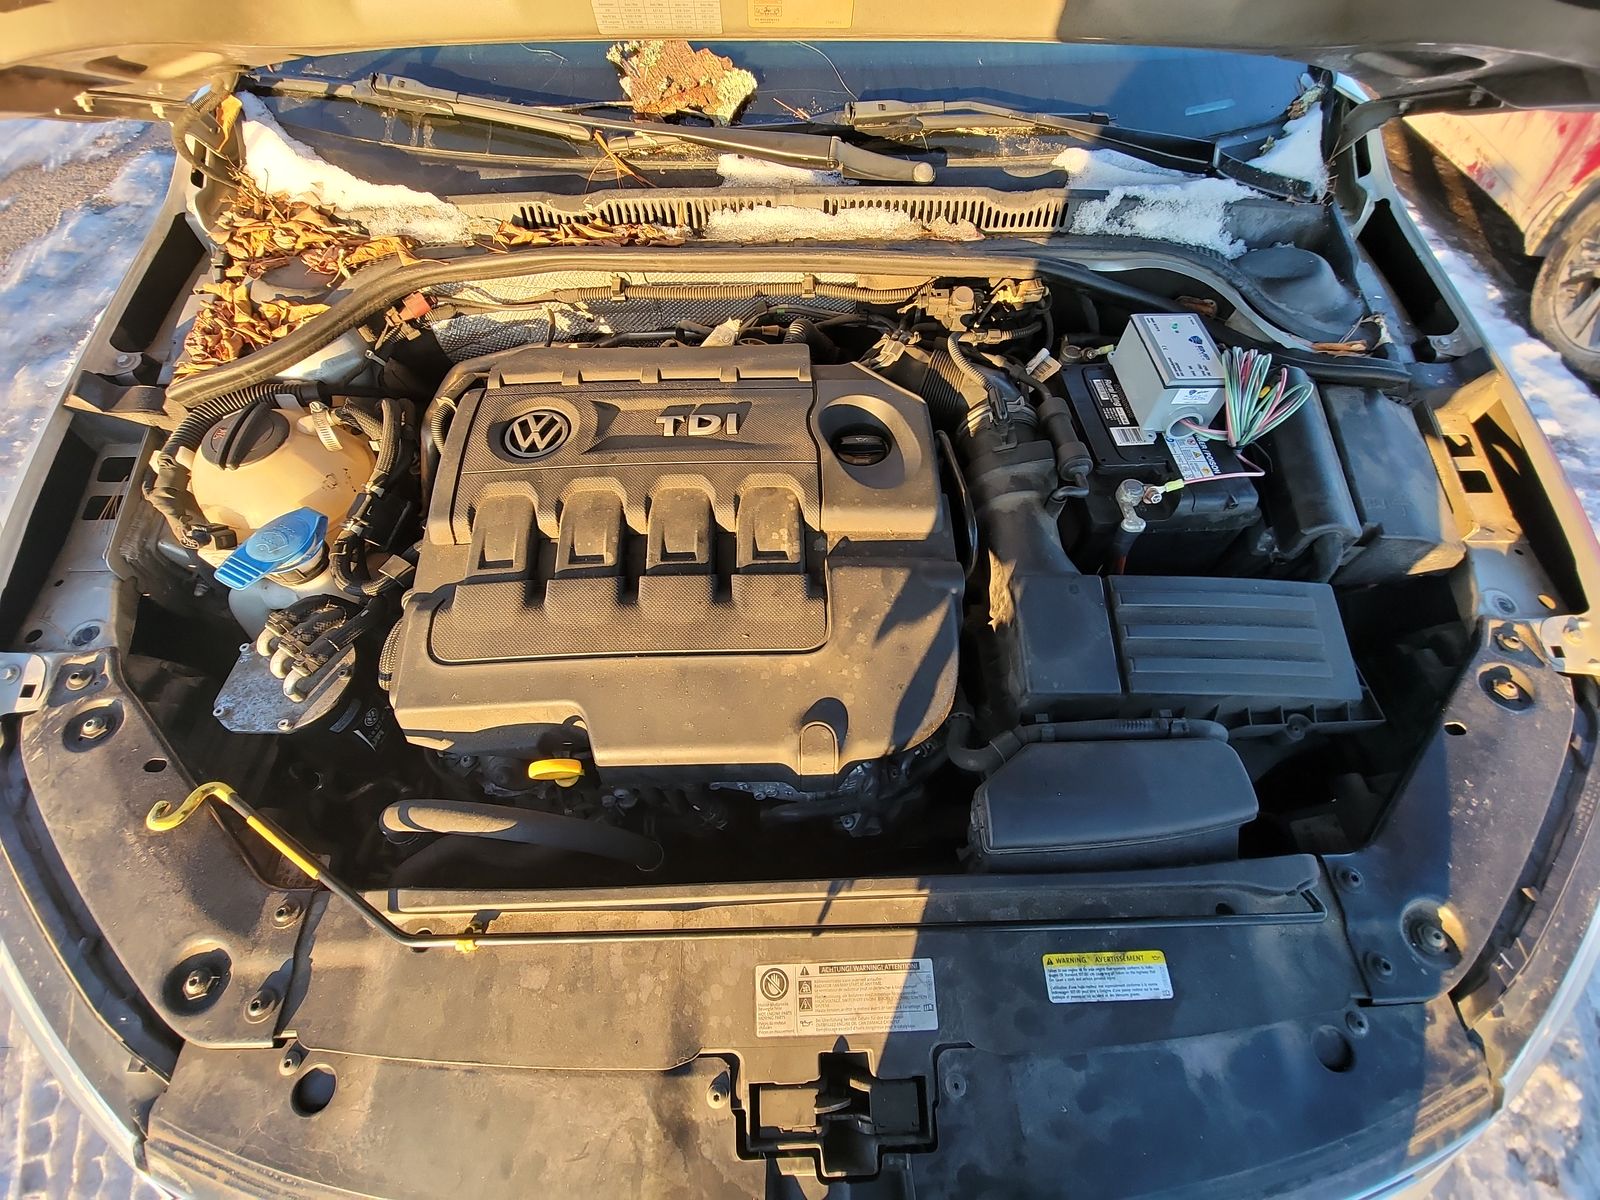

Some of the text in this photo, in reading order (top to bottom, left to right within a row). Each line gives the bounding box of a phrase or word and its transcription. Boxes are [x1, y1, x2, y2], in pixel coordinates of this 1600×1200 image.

[1103, 379, 1117, 393] Rural
[1110, 393, 1122, 407] King
[655, 413, 740, 437] TDI
[821, 962, 918, 974] ACHTUNG! WARNING! ATTENTION!
[1056, 954, 1144, 964] WARNING AVERTISSEMENT
